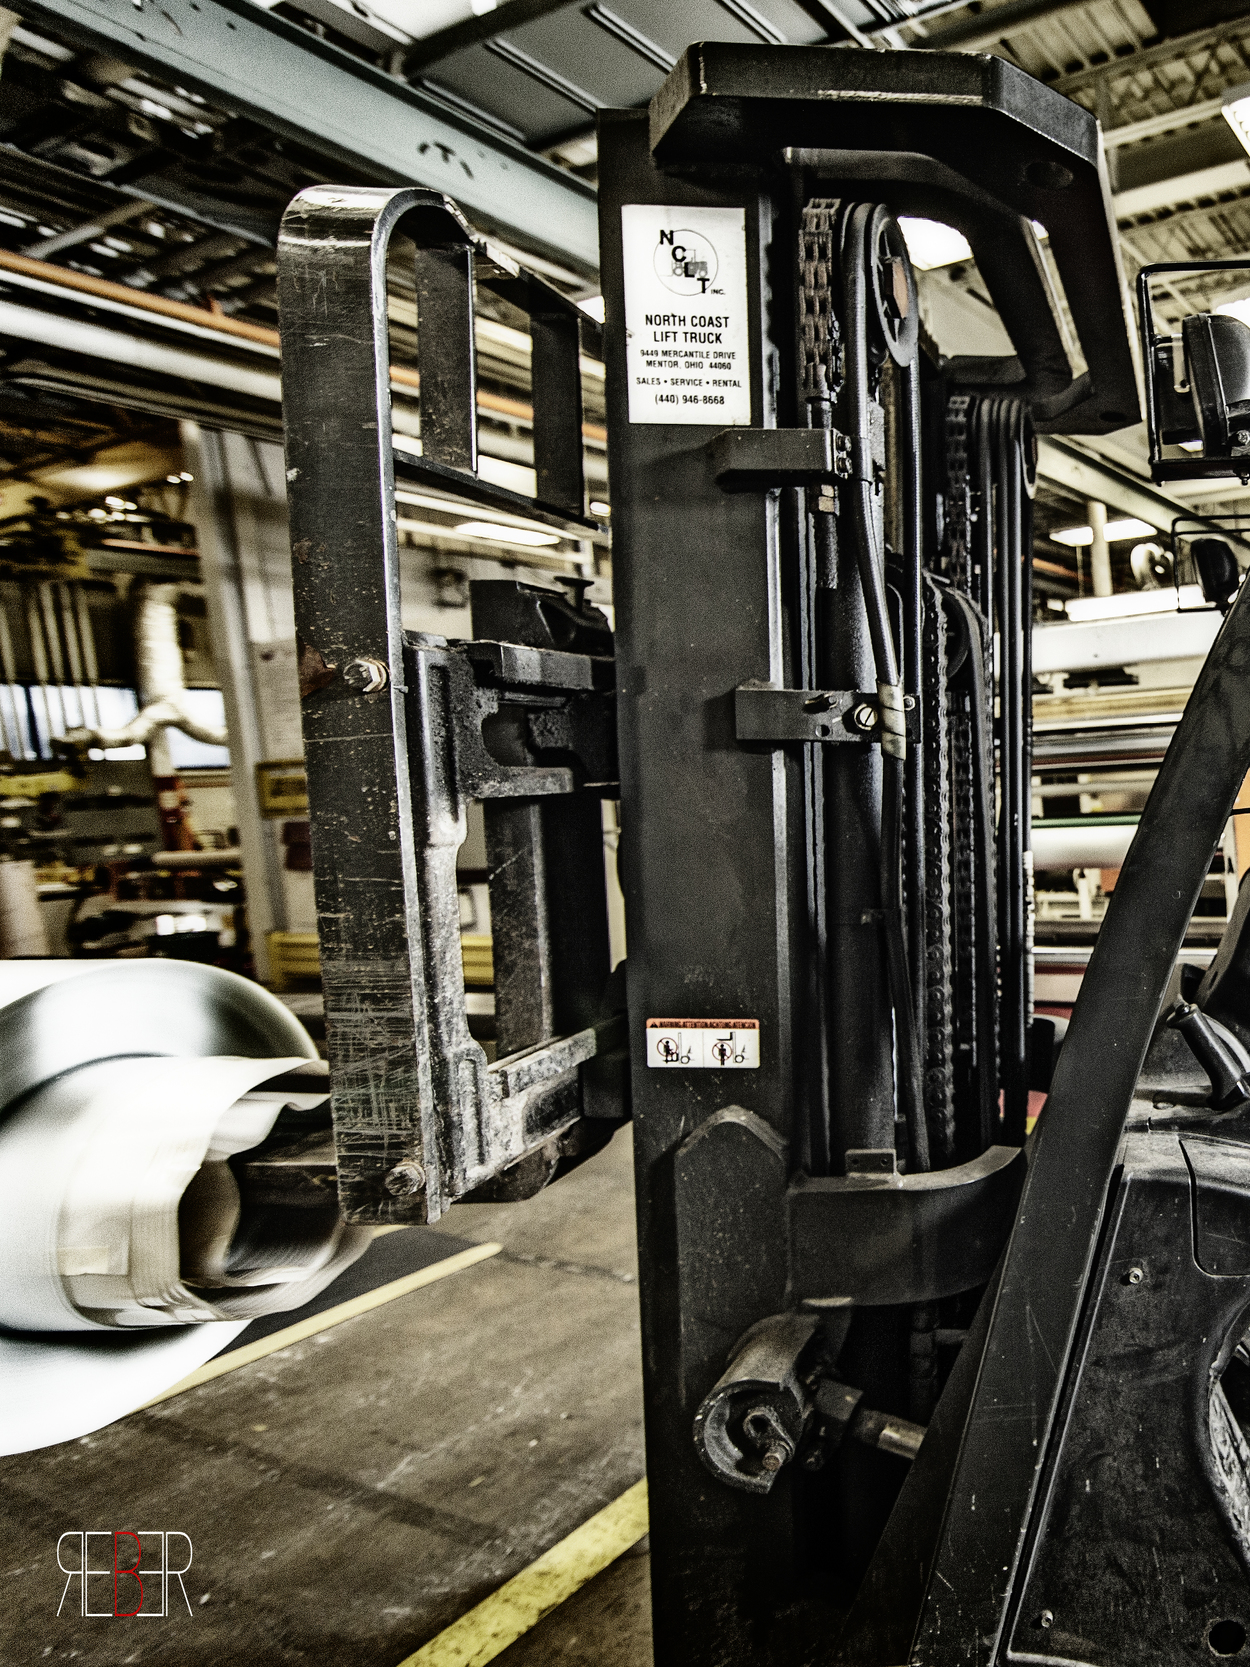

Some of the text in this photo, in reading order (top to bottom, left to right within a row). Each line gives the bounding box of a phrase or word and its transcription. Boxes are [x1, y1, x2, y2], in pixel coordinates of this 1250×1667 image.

[645, 313, 730, 328] NORTH COAST
[653, 331, 722, 344] LIFT TRUCK
[640, 349, 736, 360] 9449 MERCANTILE DRIVE
[684, 361, 704, 369] OHIO
[708, 362, 732, 370] 44060
[636, 377, 742, 388] SALES SERVICE RENTAL
[654, 394, 725, 405] (440) 946-8668
